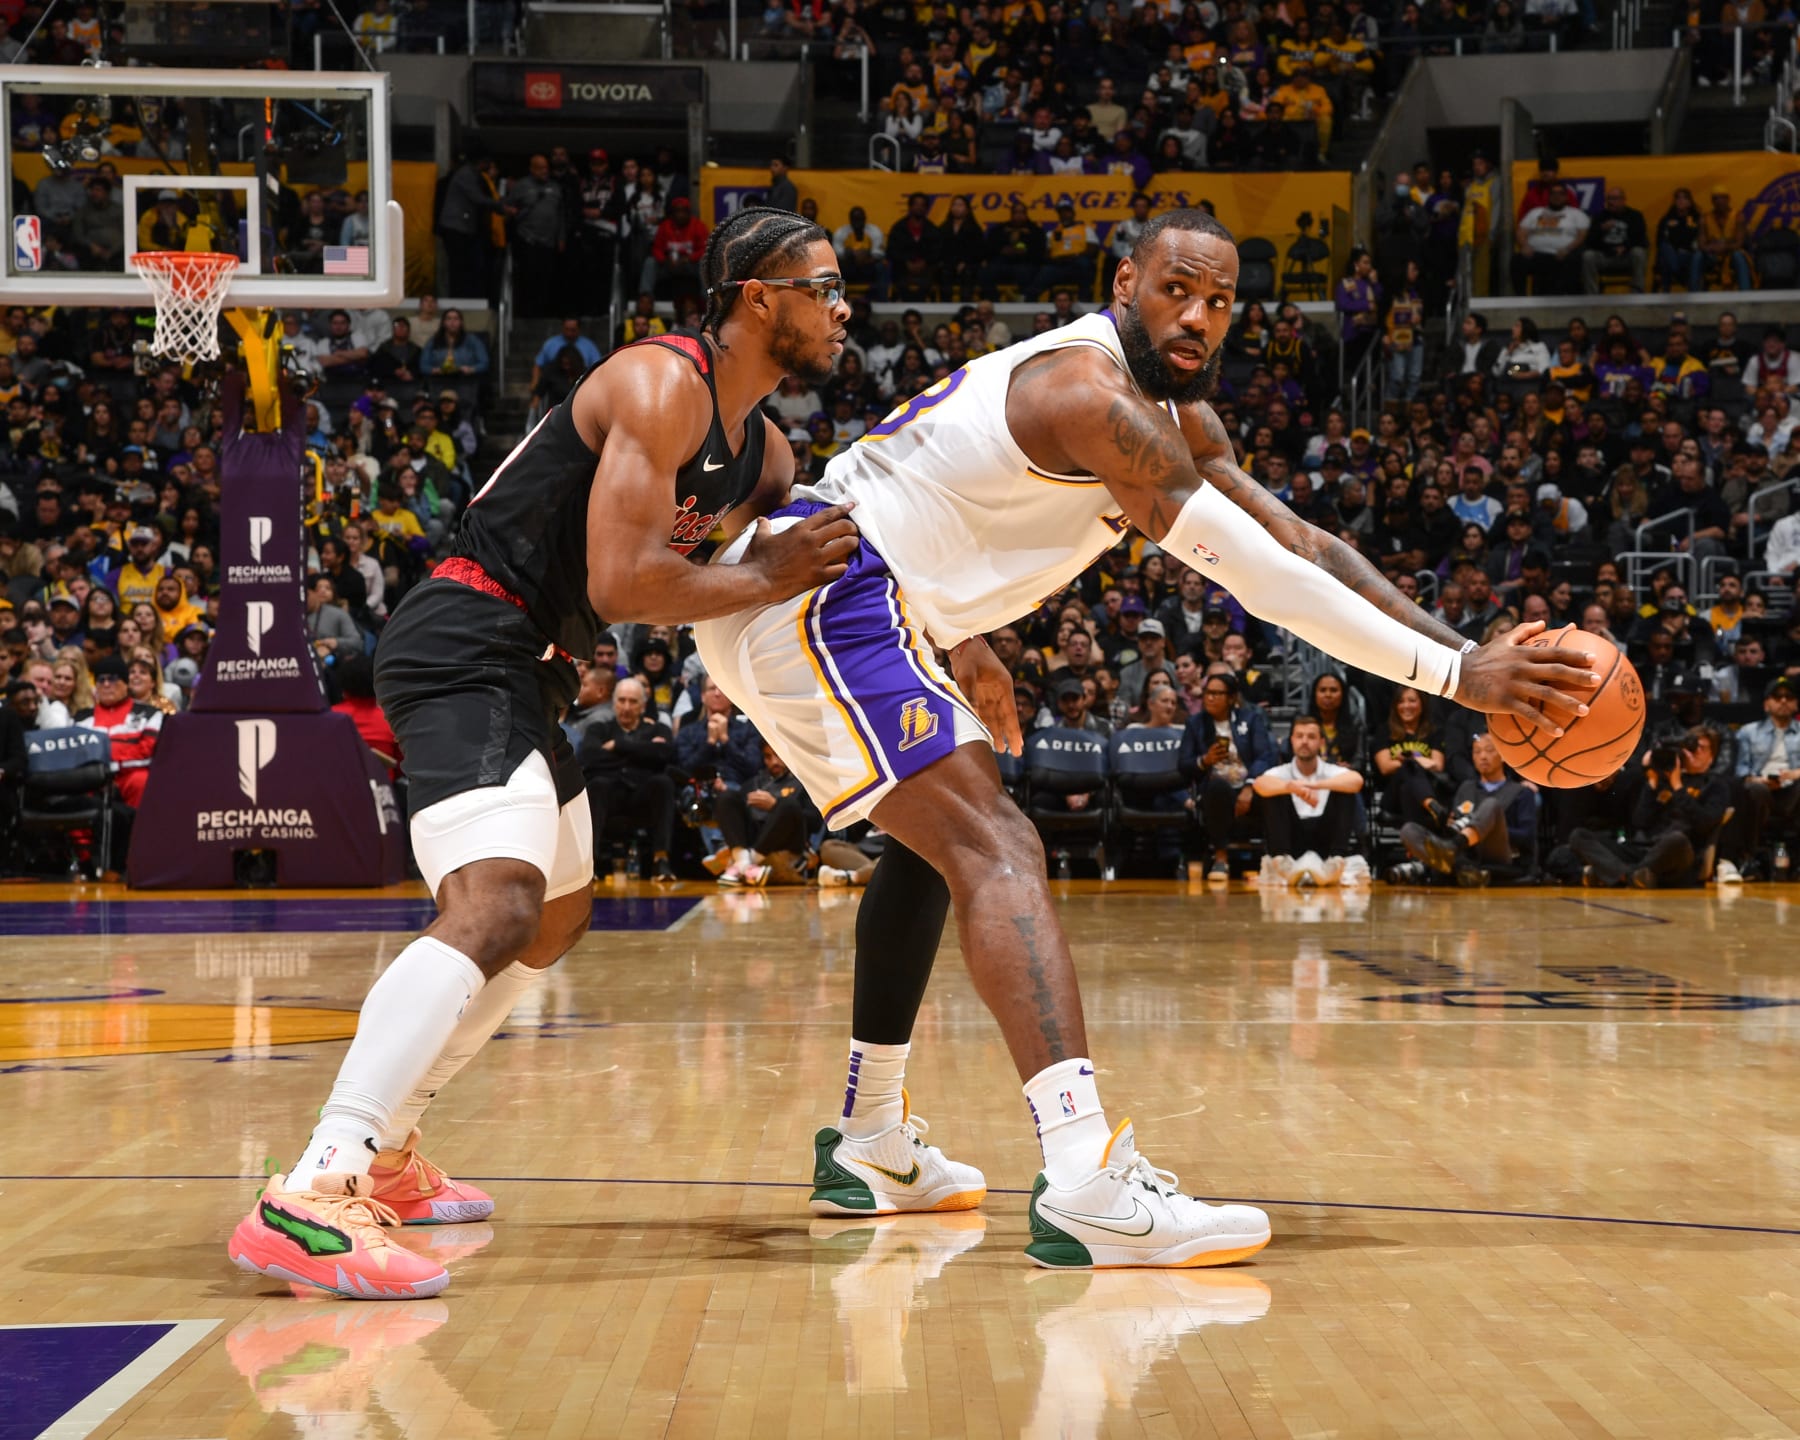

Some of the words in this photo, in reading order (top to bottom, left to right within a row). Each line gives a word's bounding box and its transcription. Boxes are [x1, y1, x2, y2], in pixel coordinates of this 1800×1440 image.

[568, 83, 653, 101] TOYOTA
[965, 191, 1024, 210] LOS
[228, 565, 291, 577] PECHANGA
[217, 657, 299, 673] PECHANGA
[216, 671, 256, 682] RESORT
[44, 733, 100, 752] DELTA
[1052, 739, 1102, 753] DELTA
[197, 809, 313, 829] PECHANGA
[197, 827, 252, 842] RESORT
